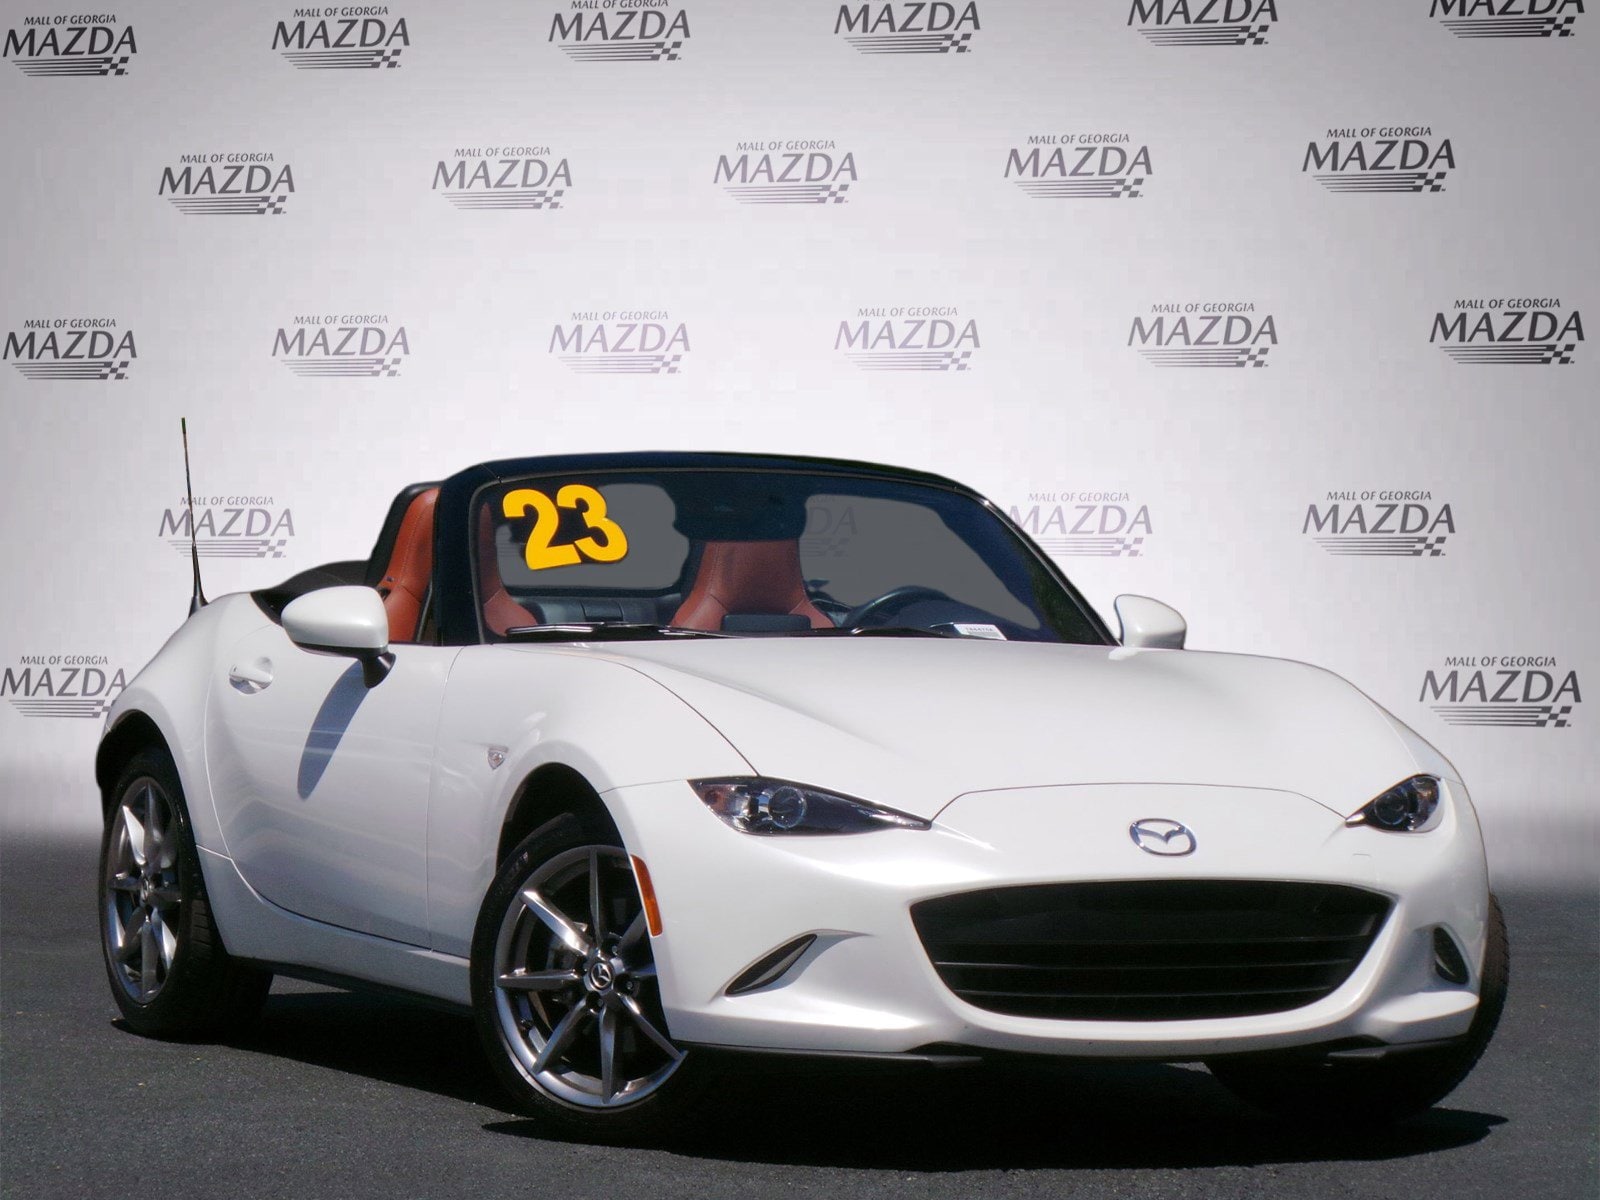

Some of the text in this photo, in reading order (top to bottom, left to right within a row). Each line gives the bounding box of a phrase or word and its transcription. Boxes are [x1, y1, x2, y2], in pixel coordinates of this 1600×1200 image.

[23, 13, 117, 26] MALL OF GEORGIA
[292, 5, 389, 18] MALL OF GEORGIA
[570, 0, 669, 10] MALL OF GEORGIA
[834, 1, 980, 34] MAZDA
[1127, 0, 1278, 26] MAZDA
[272, 18, 410, 50] MAZDA
[548, 9, 690, 42] MAZDA
[3, 26, 137, 57] MAZDA
[735, 139, 836, 152] MALL OF GEORGIA
[1026, 132, 1130, 145] MALL OF GEORGIA
[1326, 126, 1432, 139] MALL OF GEORGIA
[179, 152, 274, 164] MALL OF GEORGIA
[453, 146, 551, 158] MALL OF GEORGIA
[1004, 146, 1153, 178] MAZDA
[1302, 139, 1455, 172] MAZDA
[158, 164, 295, 195] MAZDA
[432, 158, 572, 189] MAZDA
[713, 152, 857, 184] MAZDA
[570, 310, 669, 322] MALL OF GEORGIA
[857, 306, 959, 318] MALL OF GEORGIA
[1151, 302, 1255, 314] MALL OF GEORGIA
[1453, 297, 1561, 310] MALL OF GEORGIA
[23, 318, 117, 329] MALL OF GEORGIA
[293, 314, 389, 326] MALL OF GEORGIA
[834, 318, 980, 350] MAZDA
[1128, 315, 1278, 346] MAZDA
[1429, 311, 1585, 343] MAZDA
[3, 330, 137, 360] MAZDA
[272, 327, 410, 357] MAZDA
[549, 323, 690, 353] MAZDA
[180, 495, 274, 506] MALL OF GEORGIA
[1028, 491, 1130, 503] MALL OF GEORGIA
[1326, 490, 1432, 502] MALL OF GEORGIA
[158, 508, 295, 537] MAZDA
[502, 484, 628, 570] 23
[1009, 504, 1153, 535] MAZDA
[1302, 503, 1455, 534] MAZDA
[19, 655, 109, 666] MALL OF GEORGIA
[1444, 655, 1557, 668] MALL OF GEORGIA
[0, 667, 126, 697] MAZDA
[1419, 670, 1582, 703] MAZDA
